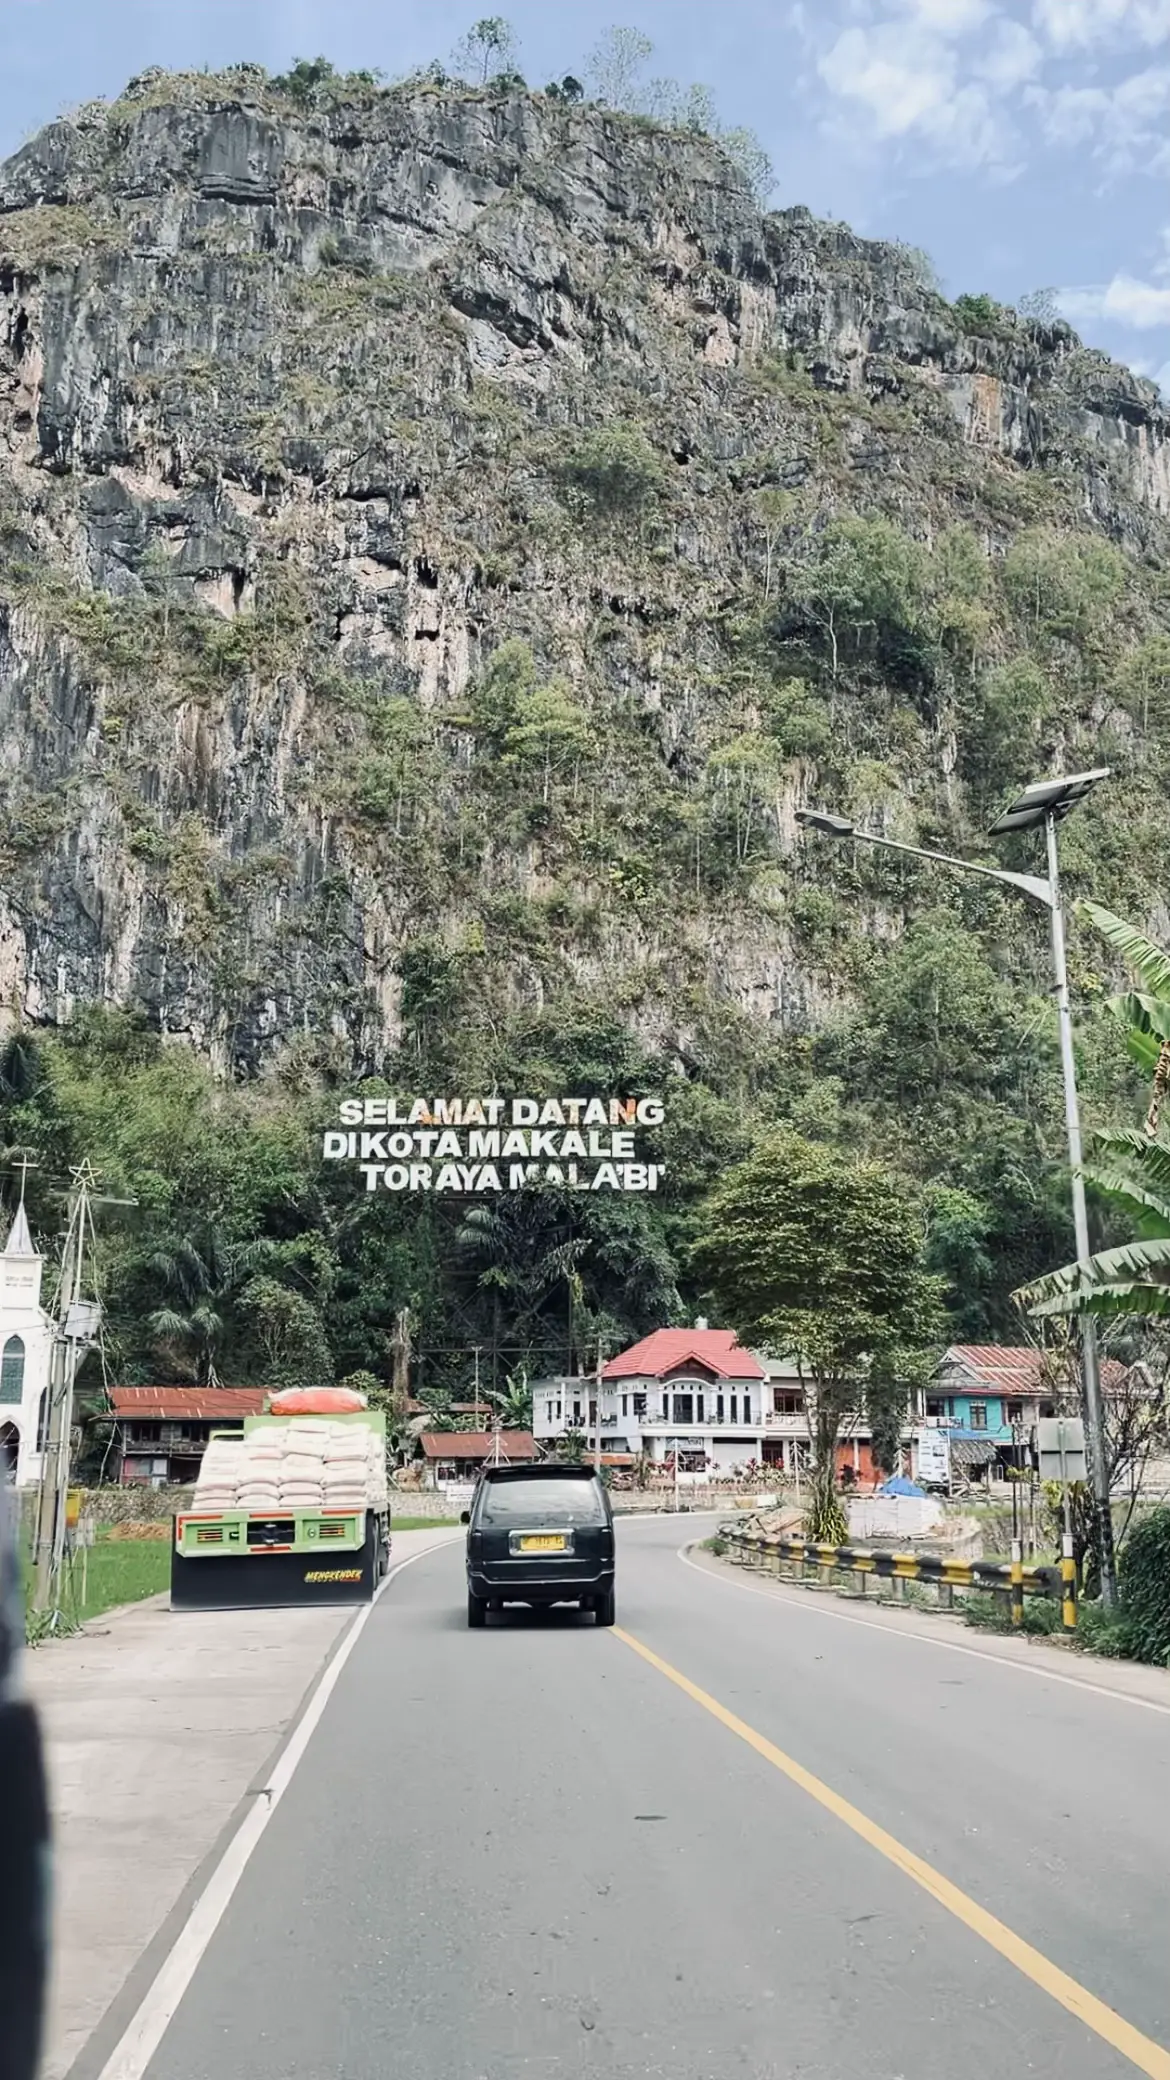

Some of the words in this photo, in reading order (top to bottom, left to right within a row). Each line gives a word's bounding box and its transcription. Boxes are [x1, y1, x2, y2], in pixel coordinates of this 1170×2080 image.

[339, 1098, 505, 1125] SELAMAT
[511, 1098, 665, 1125] DATANG
[468, 1130, 635, 1158] MAKALE
[359, 1164, 502, 1191] TORAYA
